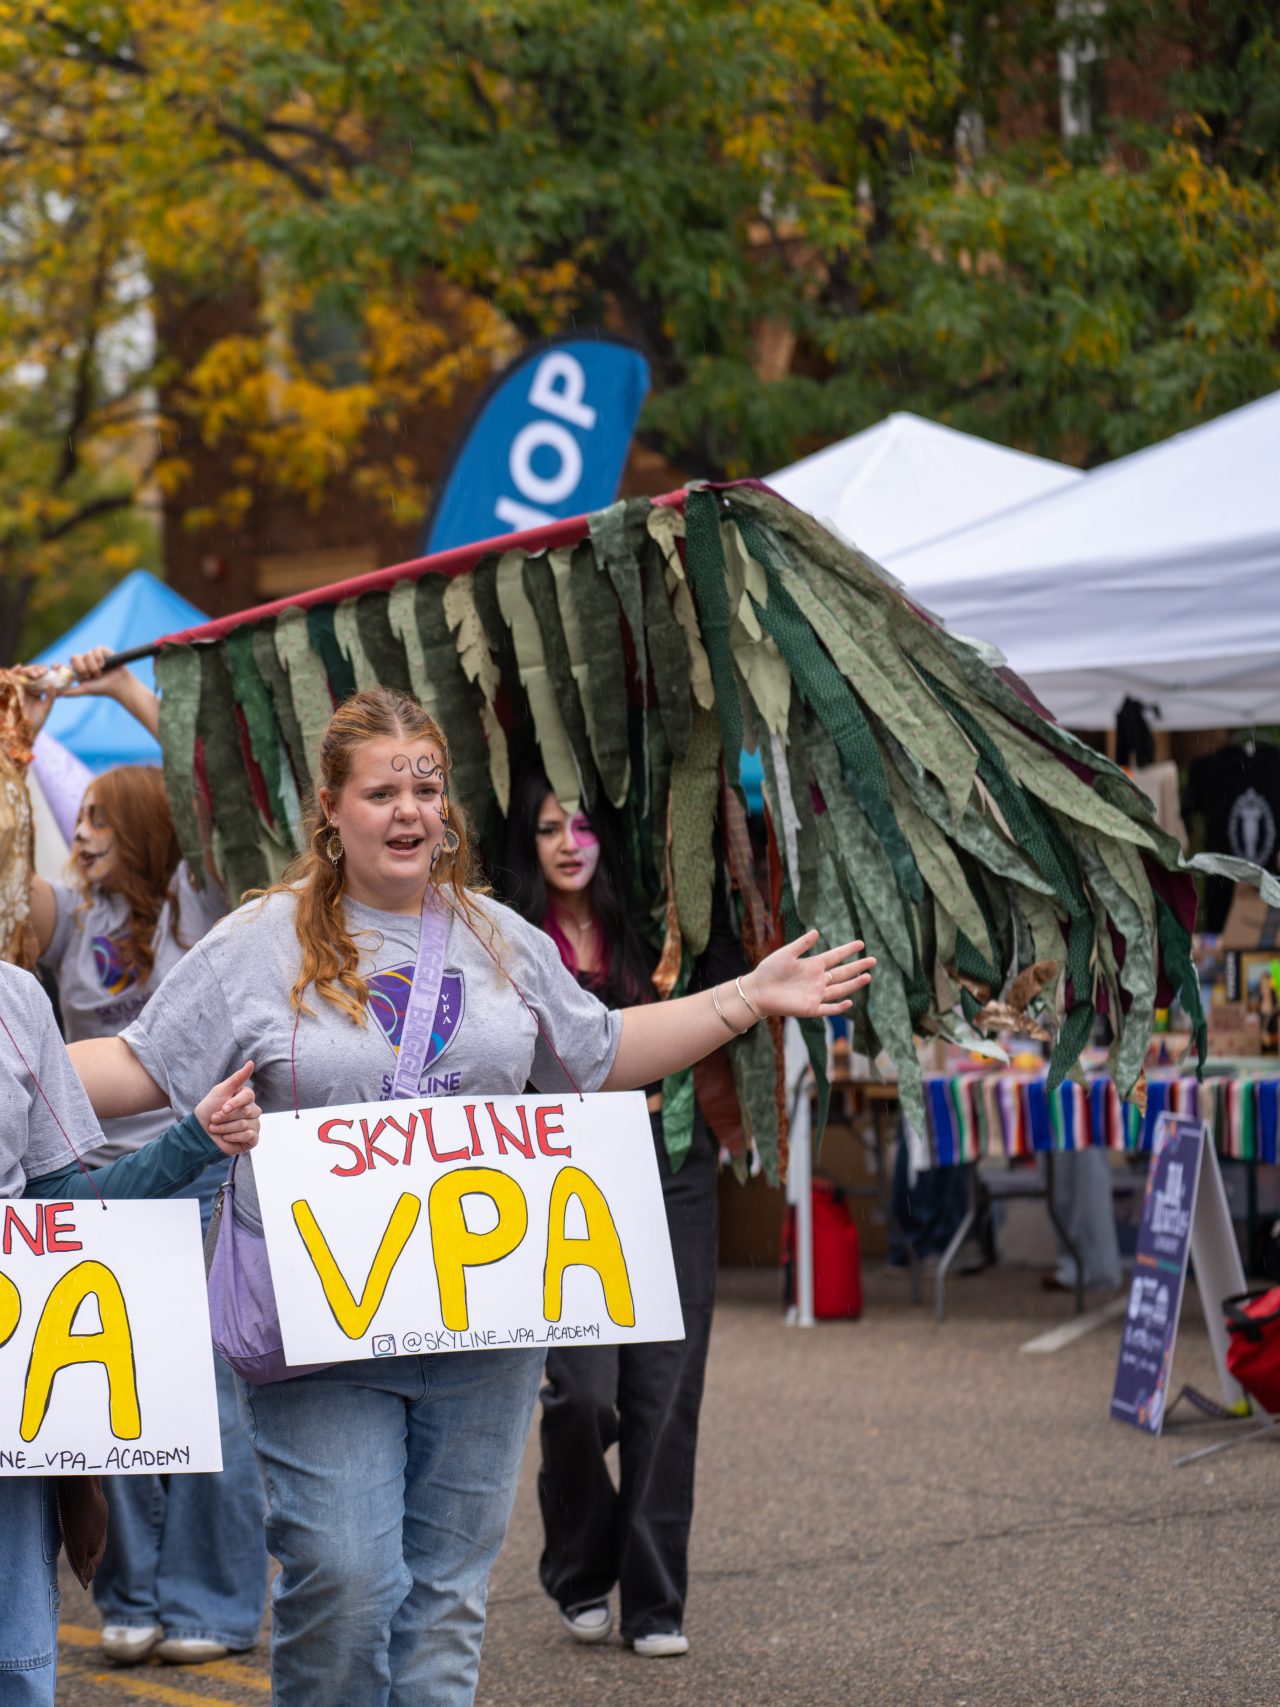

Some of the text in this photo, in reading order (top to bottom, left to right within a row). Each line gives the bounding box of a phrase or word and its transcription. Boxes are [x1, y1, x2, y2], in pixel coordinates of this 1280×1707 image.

[415, 924, 445, 997] BAGGU
[441, 993, 452, 1025] VPA
[382, 1072, 462, 1095] SLINE
[317, 1102, 572, 1177] SKYLINE
[291, 1166, 635, 1340] VPA
[403, 1323, 600, 1351] @SKYLINE_VPA_ACADEMY
